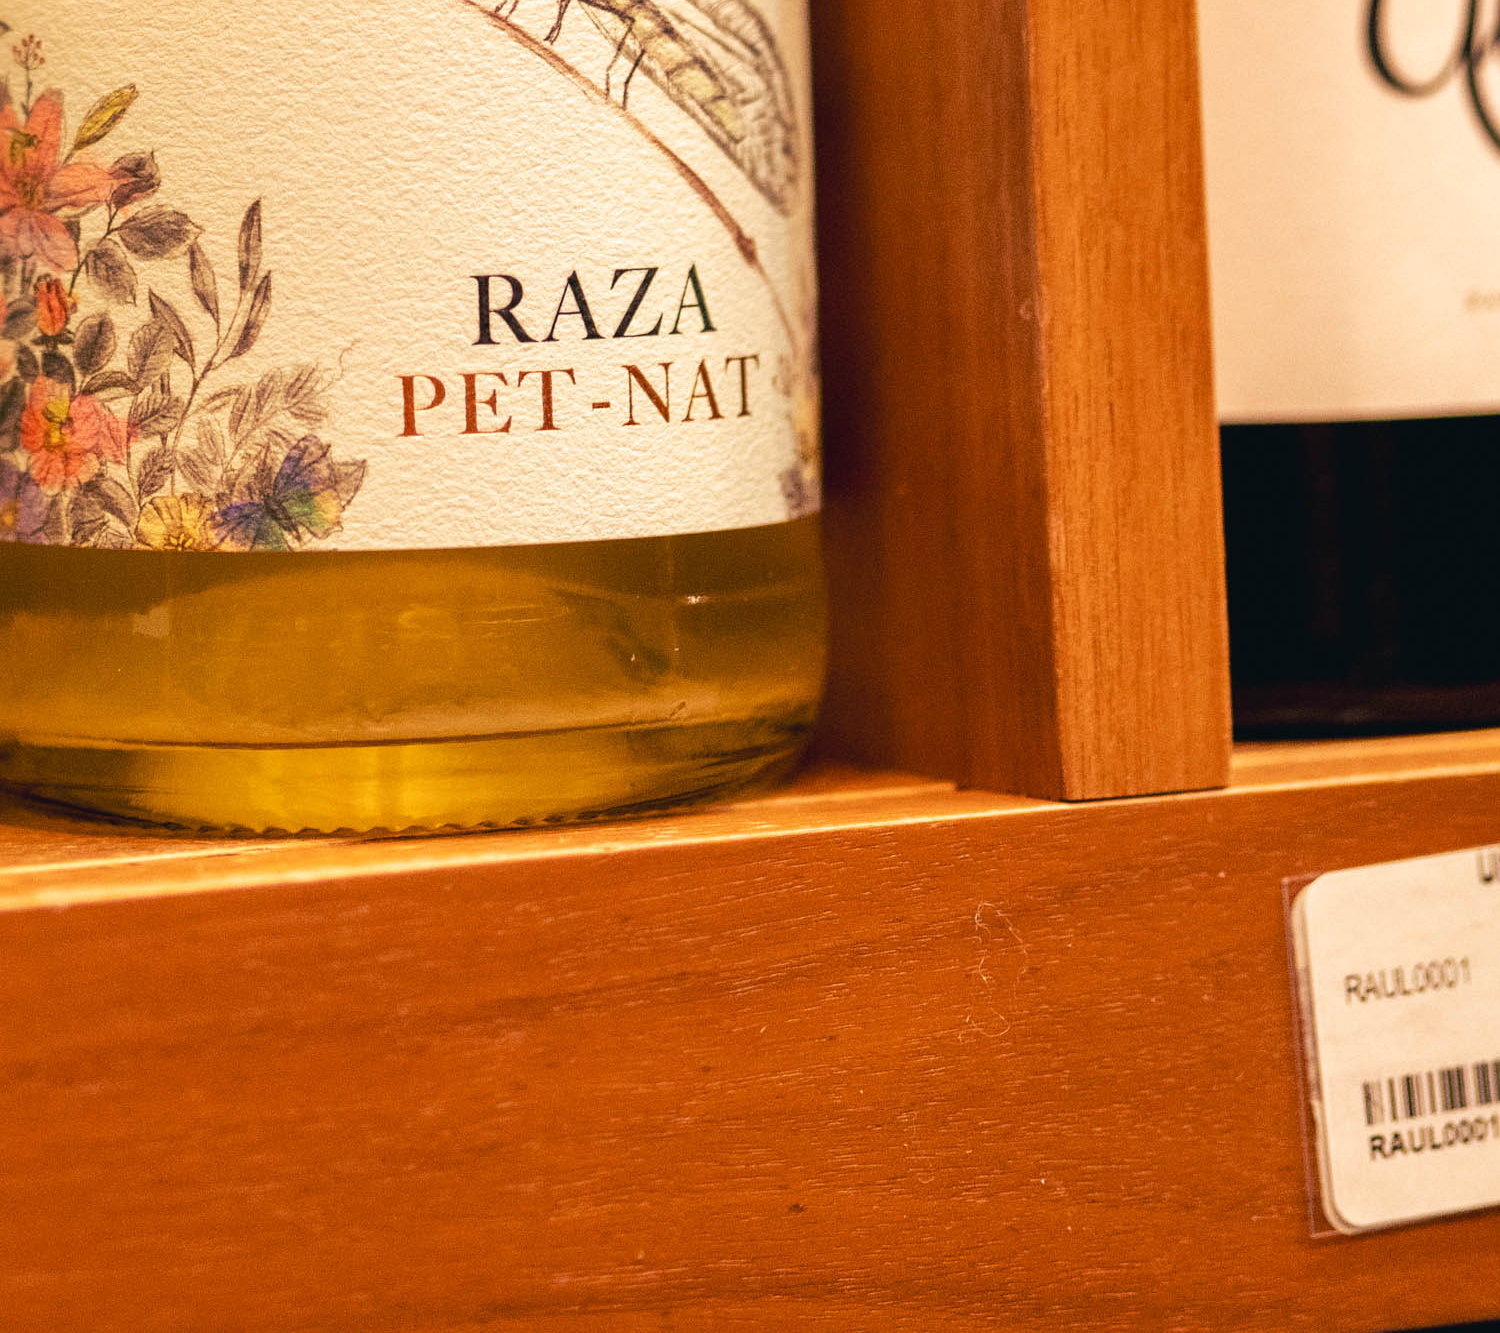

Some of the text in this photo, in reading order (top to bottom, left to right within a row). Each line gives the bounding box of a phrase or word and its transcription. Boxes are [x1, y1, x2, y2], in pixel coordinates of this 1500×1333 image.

[472, 263, 718, 347] RAZA
[396, 355, 760, 438] PET-NAT
[1344, 957, 1472, 1005] RAUL0001
